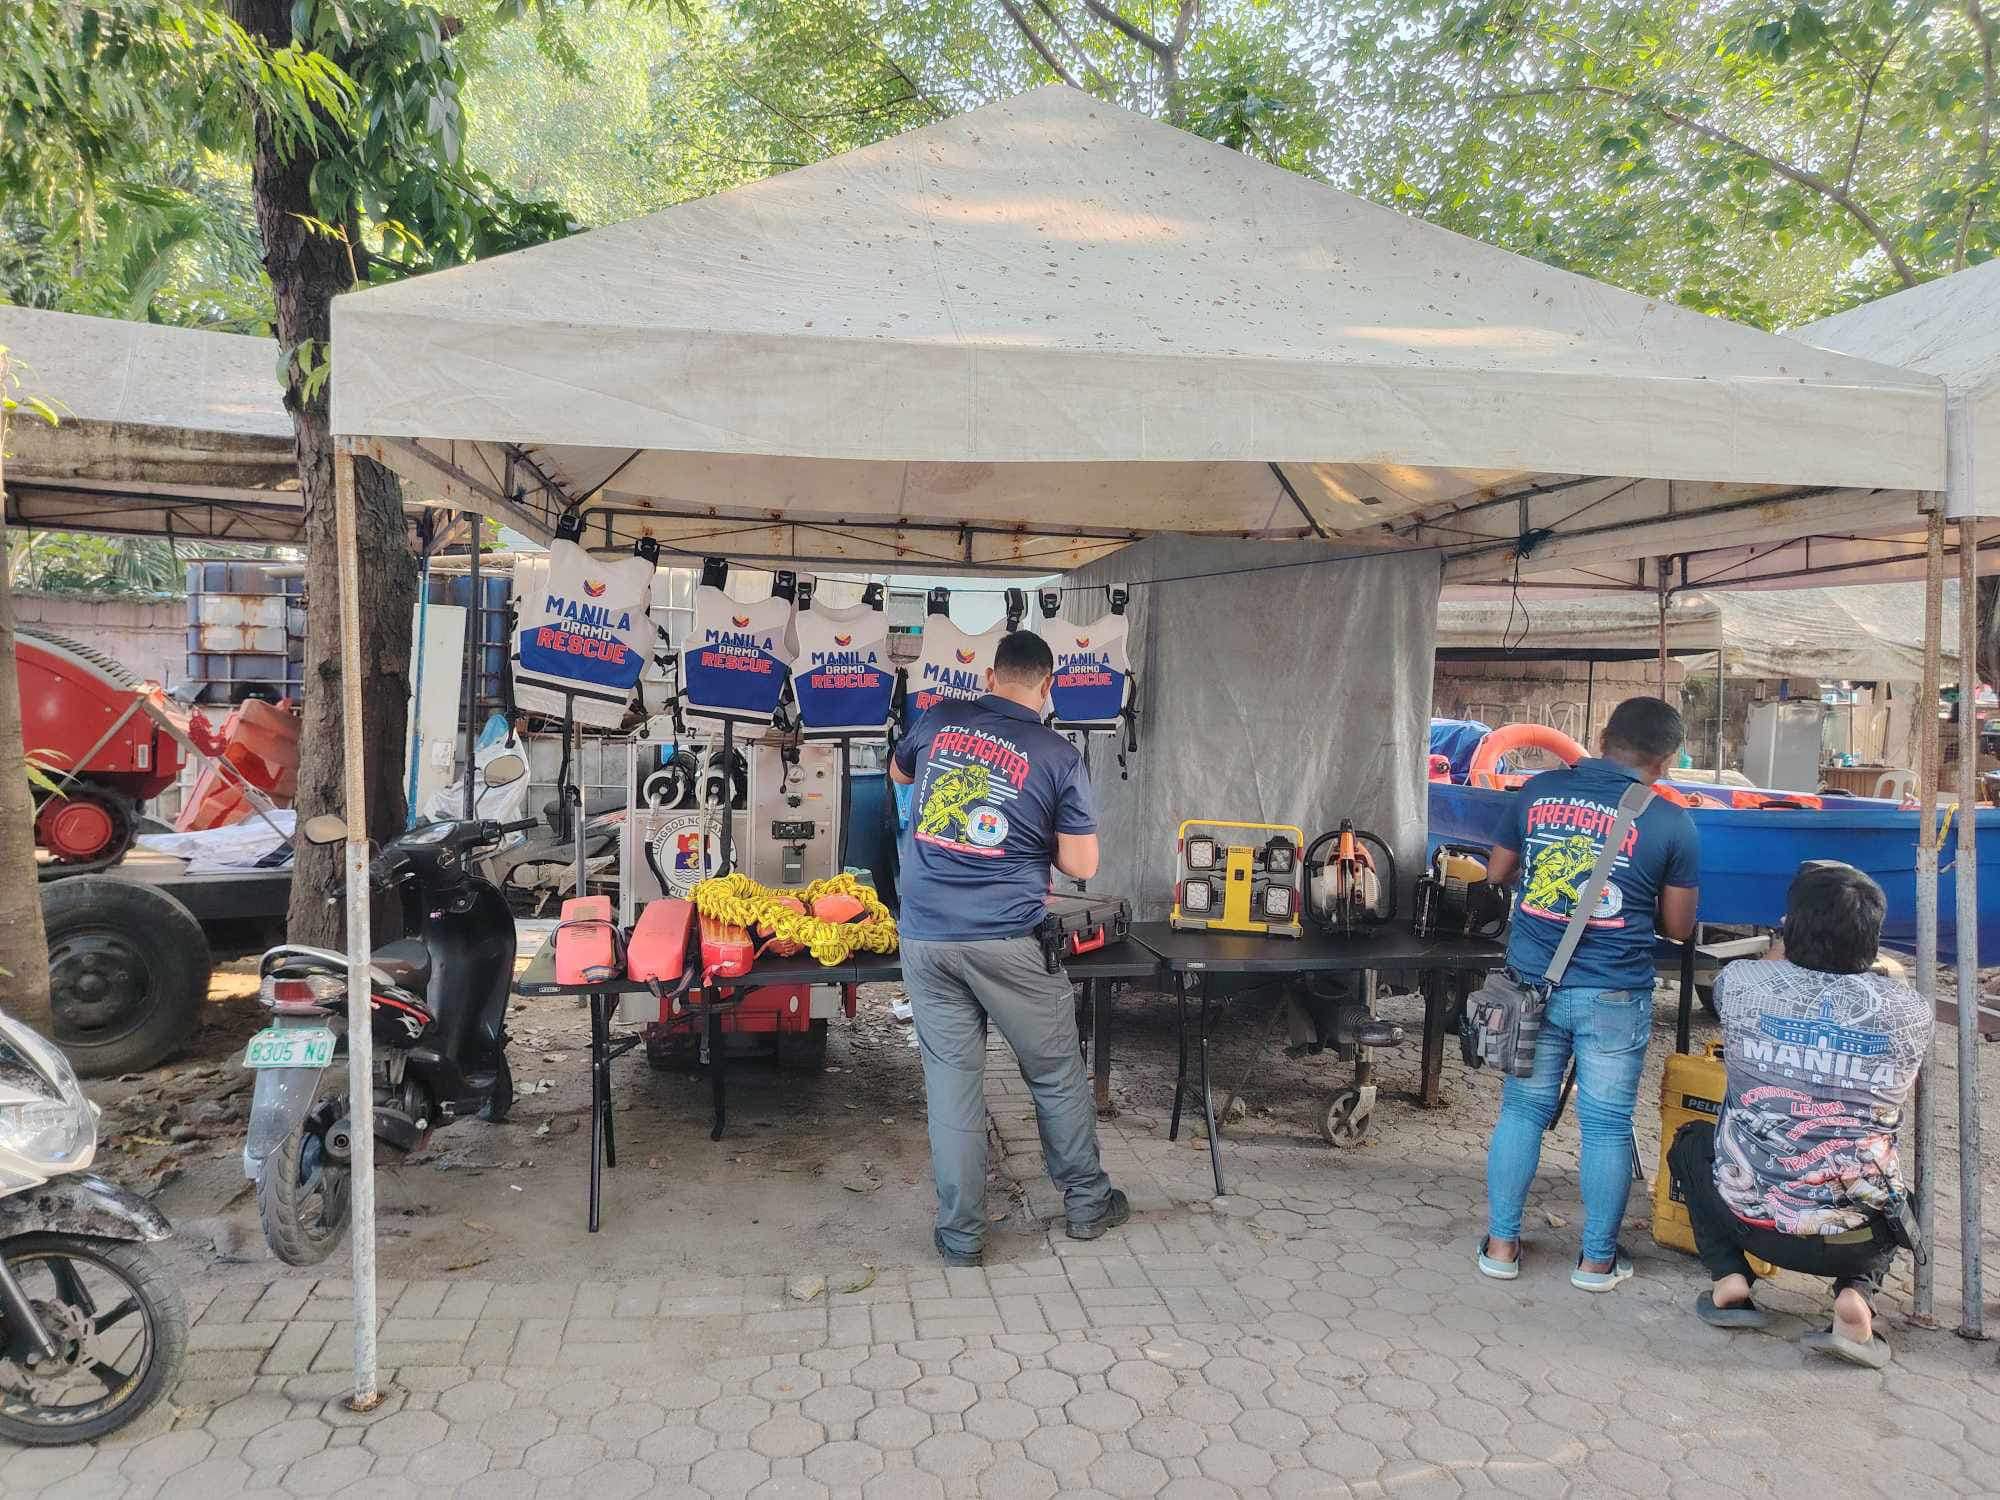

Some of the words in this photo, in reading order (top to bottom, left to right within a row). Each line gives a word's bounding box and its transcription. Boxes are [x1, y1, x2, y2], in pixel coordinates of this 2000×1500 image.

[545, 594, 631, 632] MANILA
[560, 619, 613, 641] DRRMO
[705, 628, 773, 651] MANILA
[536, 628, 629, 665] RESCUE
[719, 645, 760, 659] DRRMO
[702, 651, 773, 674] RESCUE
[811, 651, 878, 665] MANILA
[1058, 652, 1110, 666] MANILA
[825, 665, 865, 674] DRRMO
[923, 662, 985, 692] MANIL
[1058, 672, 1113, 688] RESCUE
[1069, 665, 1100, 674] DRRMO
[811, 673, 880, 689] RESCUE
[940, 725, 970, 735] 4TH
[974, 729, 1028, 763] MANILA
[928, 732, 1031, 791] FIREFIGHTER
[940, 749, 1009, 776] SUMMIT
[1533, 797, 1564, 807] 4TH
[652, 818, 685, 855] LUNGSOD
[1526, 804, 1639, 857] FIREFIGHTR
[1536, 823, 1603, 839] SUMMI
[251, 1041, 292, 1061] 8305
[1743, 1037, 1895, 1088] MANILA
[1791, 1101, 1846, 1117] LEARN
[1777, 1138, 1854, 1172] TRAINING
